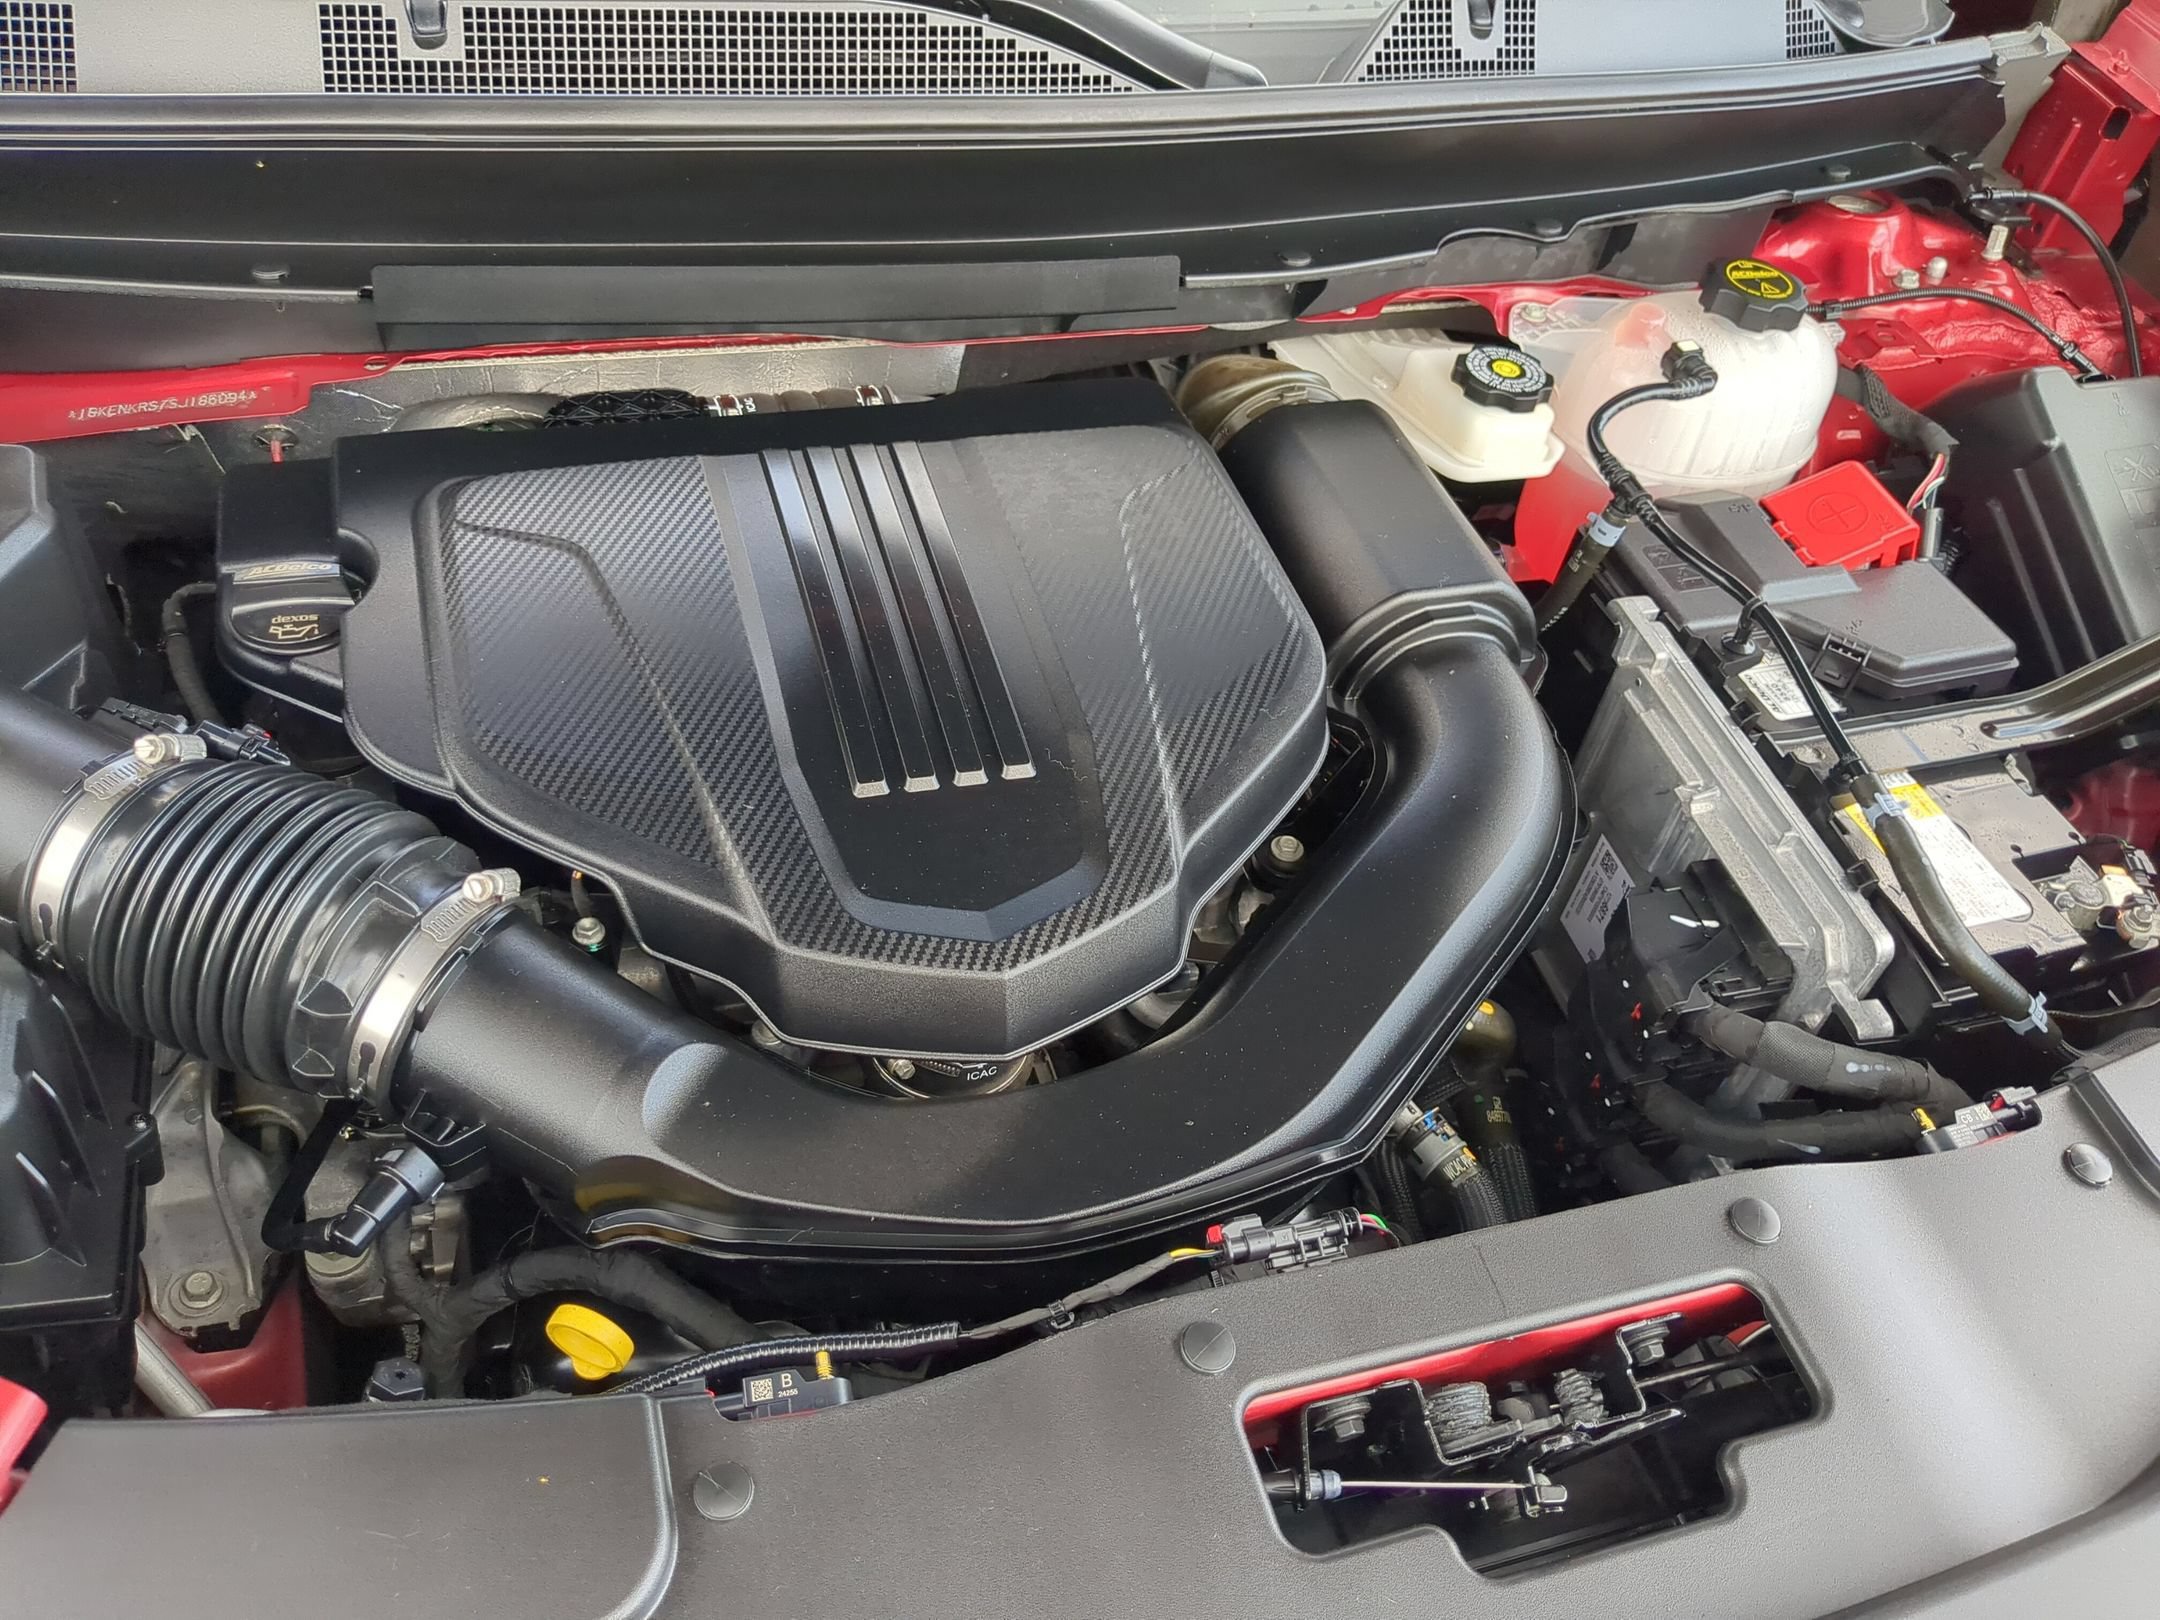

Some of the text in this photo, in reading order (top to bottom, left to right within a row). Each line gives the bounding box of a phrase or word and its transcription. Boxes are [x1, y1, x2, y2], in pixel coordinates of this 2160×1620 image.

[271, 613, 320, 624] dexos
[966, 1065, 998, 1081] ICAC
[781, 1373, 793, 1388] B
